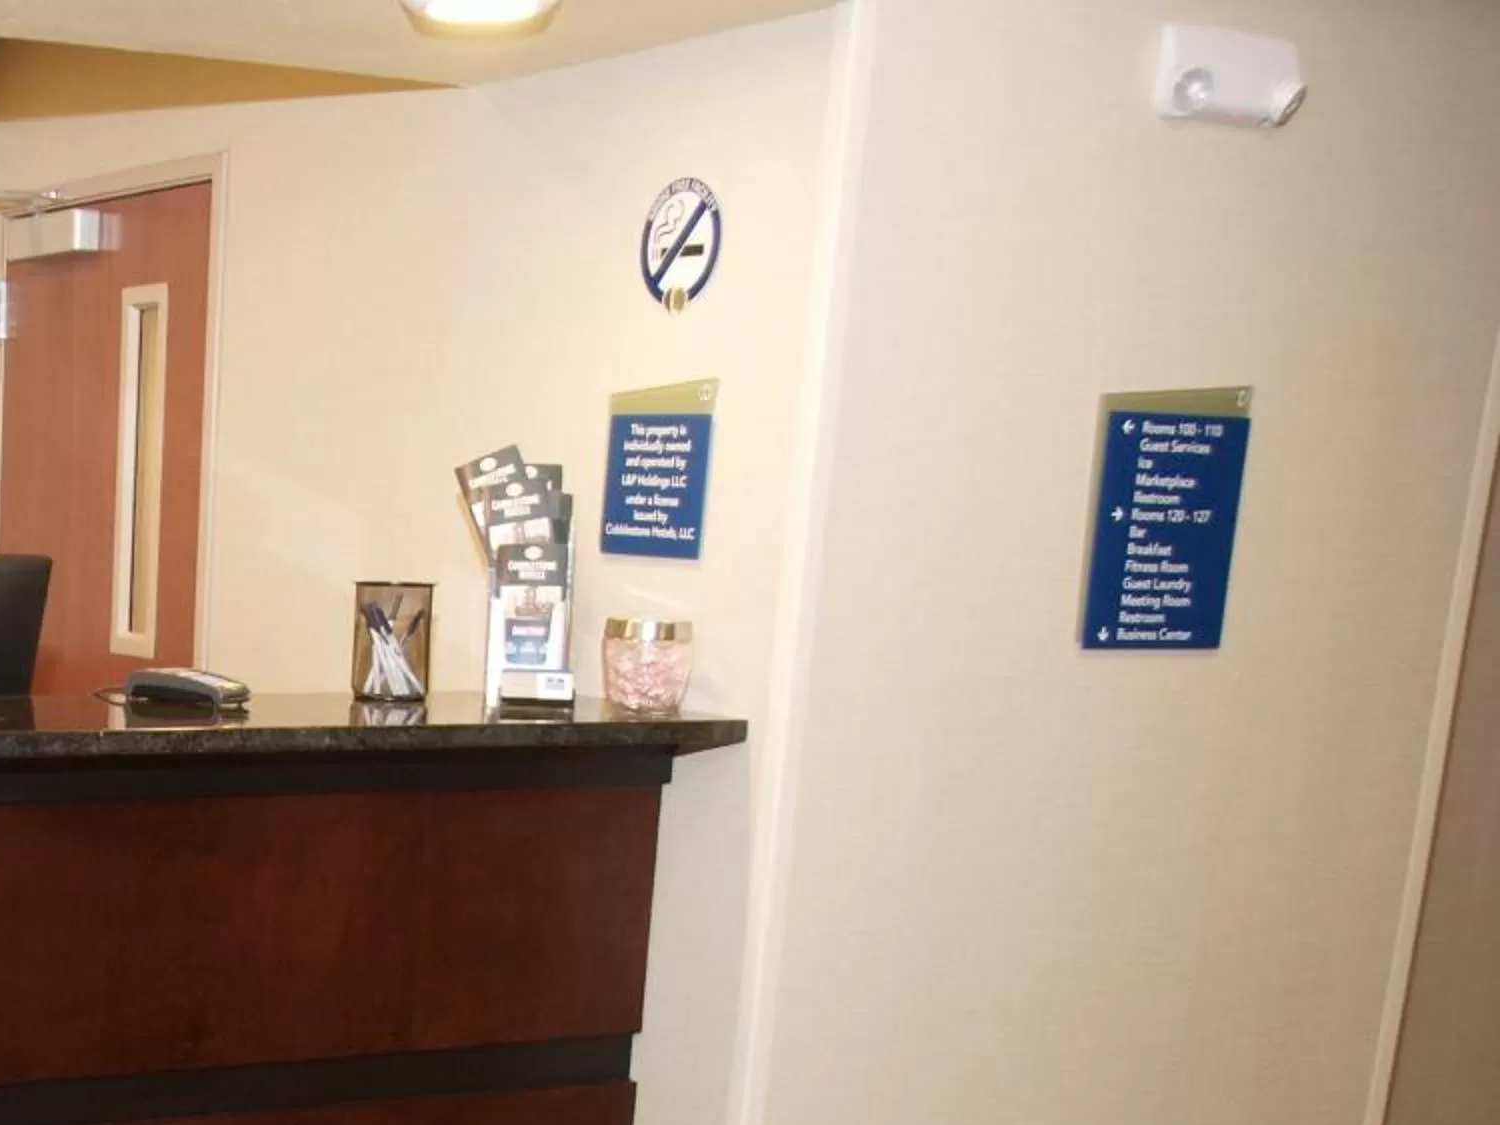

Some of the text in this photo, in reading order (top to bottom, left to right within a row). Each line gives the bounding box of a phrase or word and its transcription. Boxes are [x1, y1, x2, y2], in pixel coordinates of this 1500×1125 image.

[1141, 420, 1176, 436] Rooms
[1139, 437, 1211, 455] Guest Services
[1135, 472, 1197, 491] Marketplace
[1131, 507, 1166, 523] Rooms
[678, 527, 696, 540] LLC
[1126, 541, 1172, 557] Breakfast
[1122, 576, 1193, 594] Guest Laundry
[1120, 593, 1161, 611] Meeting
[1159, 627, 1193, 641] Center
